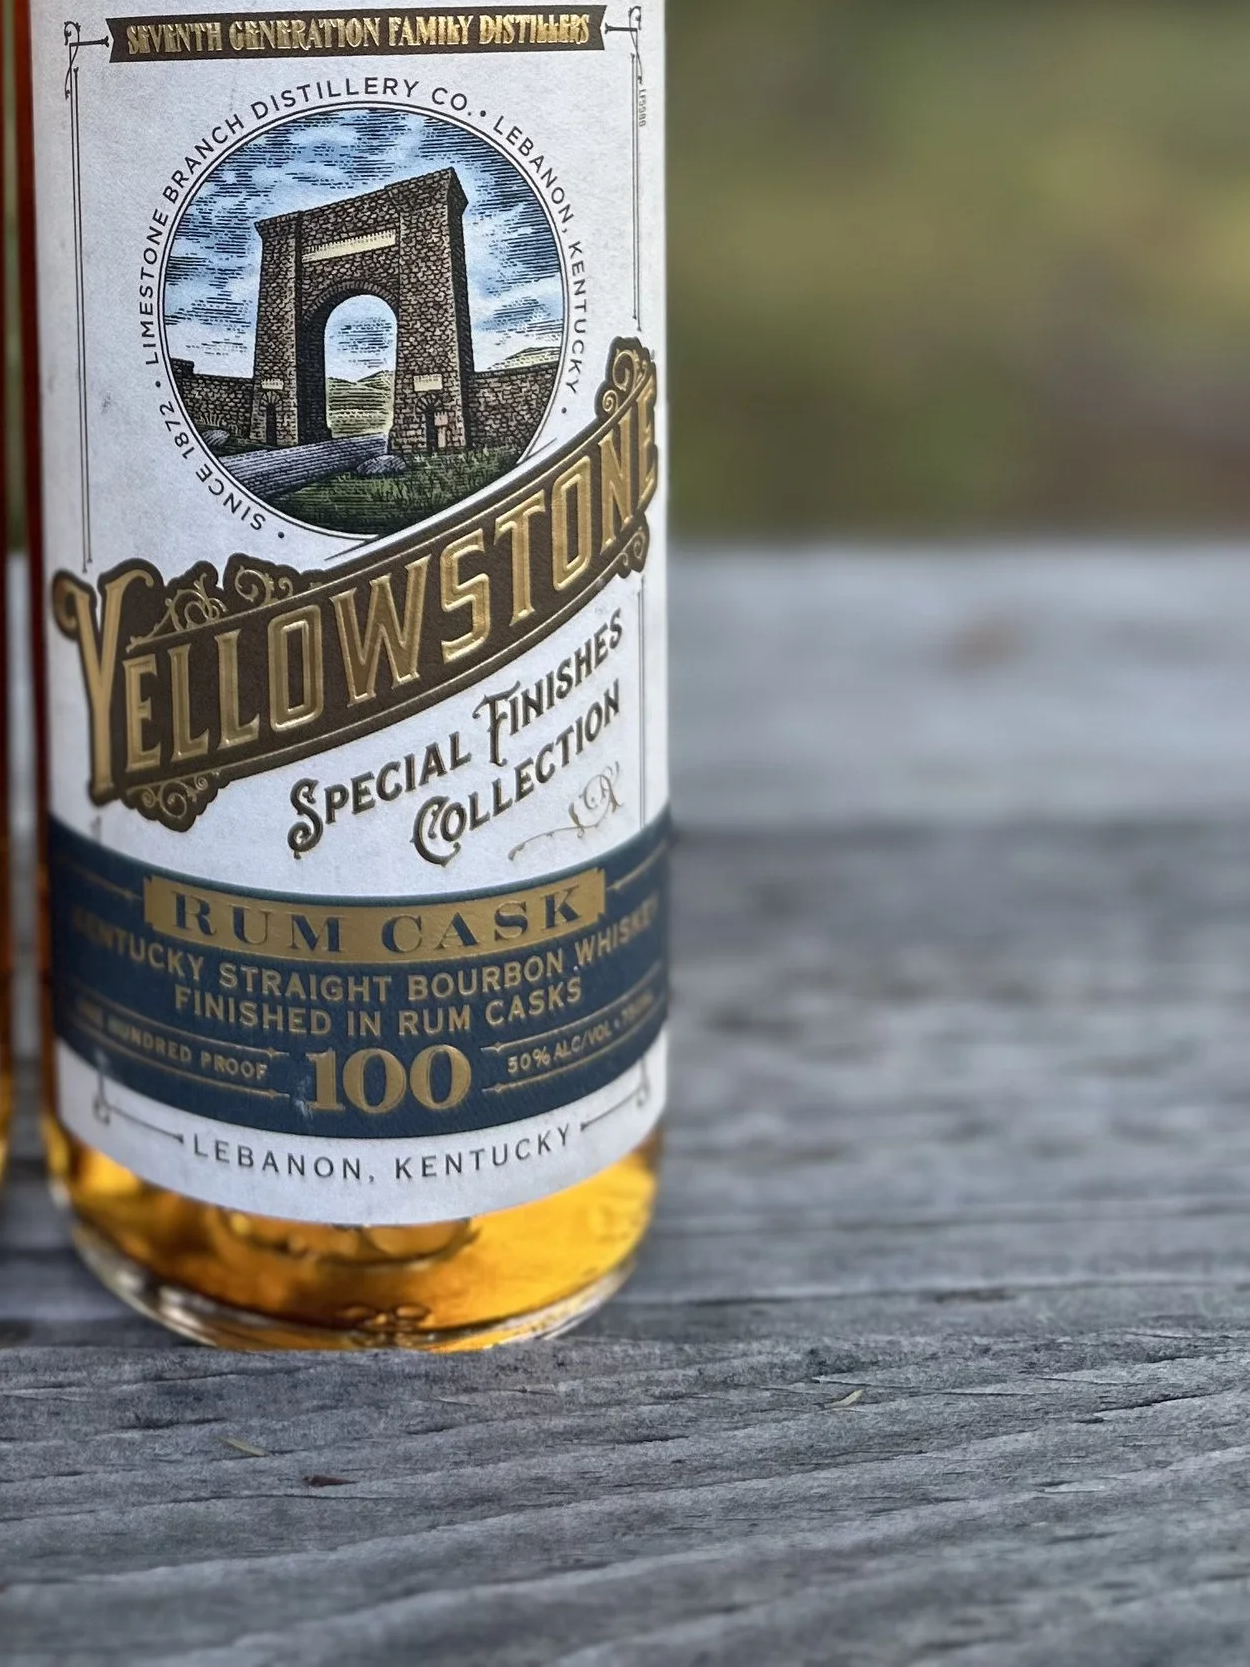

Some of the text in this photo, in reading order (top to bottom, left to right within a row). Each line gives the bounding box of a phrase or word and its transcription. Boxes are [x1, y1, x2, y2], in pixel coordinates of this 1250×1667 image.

[127, 13, 589, 55] SEVENTH GENERATION FAMILY DISTILLERS
[140, 76, 587, 395] LIMESTONE BRANCH DISTILLERY CO. LEBANON, KENTUCKY
[159, 400, 266, 530] SINCE 1872
[55, 374, 655, 794] YELLOWSTONE
[287, 609, 625, 859] SPECIAL FINISHES
[411, 678, 622, 867] COLLECTION
[73, 907, 204, 981] NTUCKY
[219, 961, 392, 1003] STRAIGHT
[407, 947, 563, 1002] BOURBON
[170, 884, 587, 955] RUM CASK
[175, 984, 332, 1036] FINISHED
[347, 1008, 382, 1037] IN
[398, 1007, 472, 1038] RUM
[485, 976, 581, 1026] CASKS
[201, 1052, 268, 1080] PROOF
[306, 1044, 472, 1114] 100
[507, 1020, 612, 1074] 50% ALC/VOL
[193, 1123, 573, 1184] LEBANON, KENTUCKY
